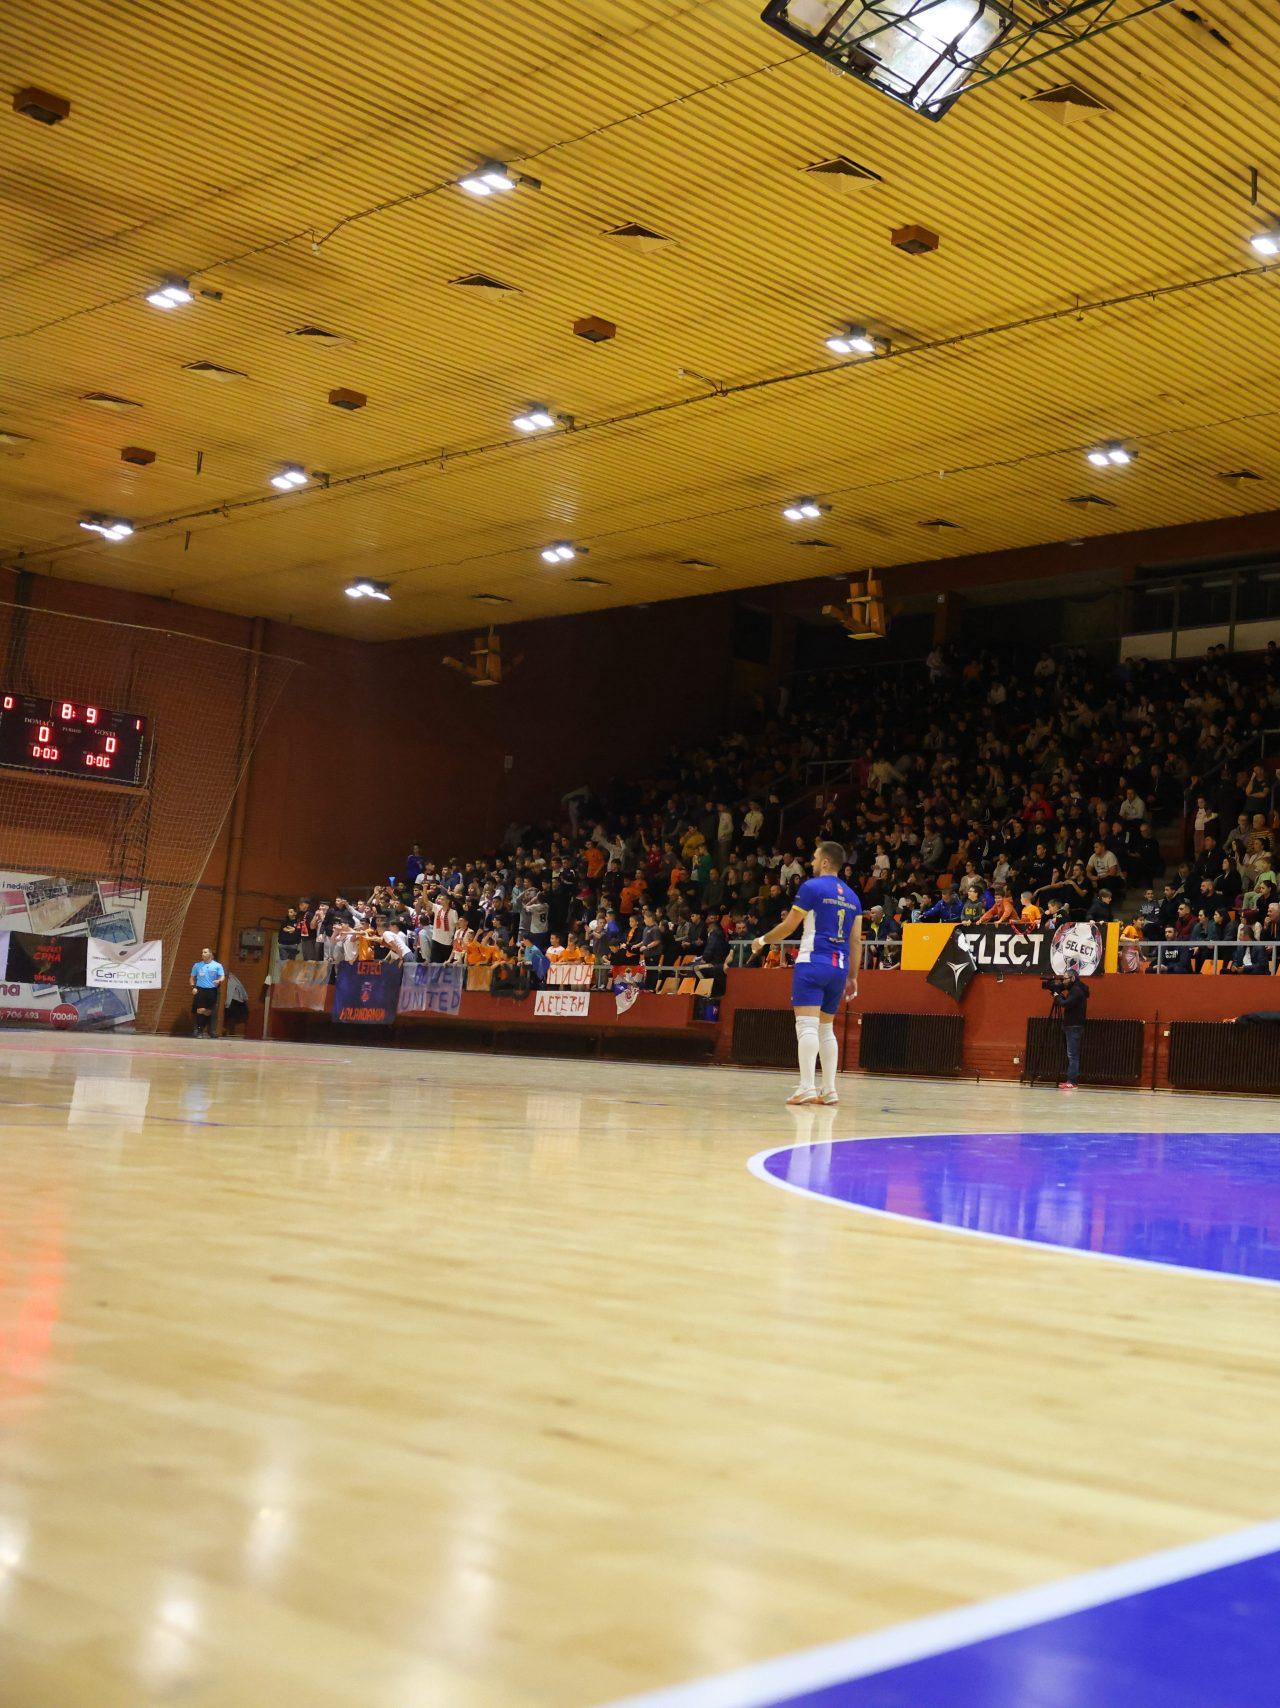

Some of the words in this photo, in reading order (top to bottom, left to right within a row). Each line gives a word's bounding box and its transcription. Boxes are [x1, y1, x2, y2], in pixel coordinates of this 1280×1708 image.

[38, 726, 49, 743] 0
[105, 737, 116, 753] 0
[837, 908, 846, 938] 1
[964, 933, 1044, 965] ELECT
